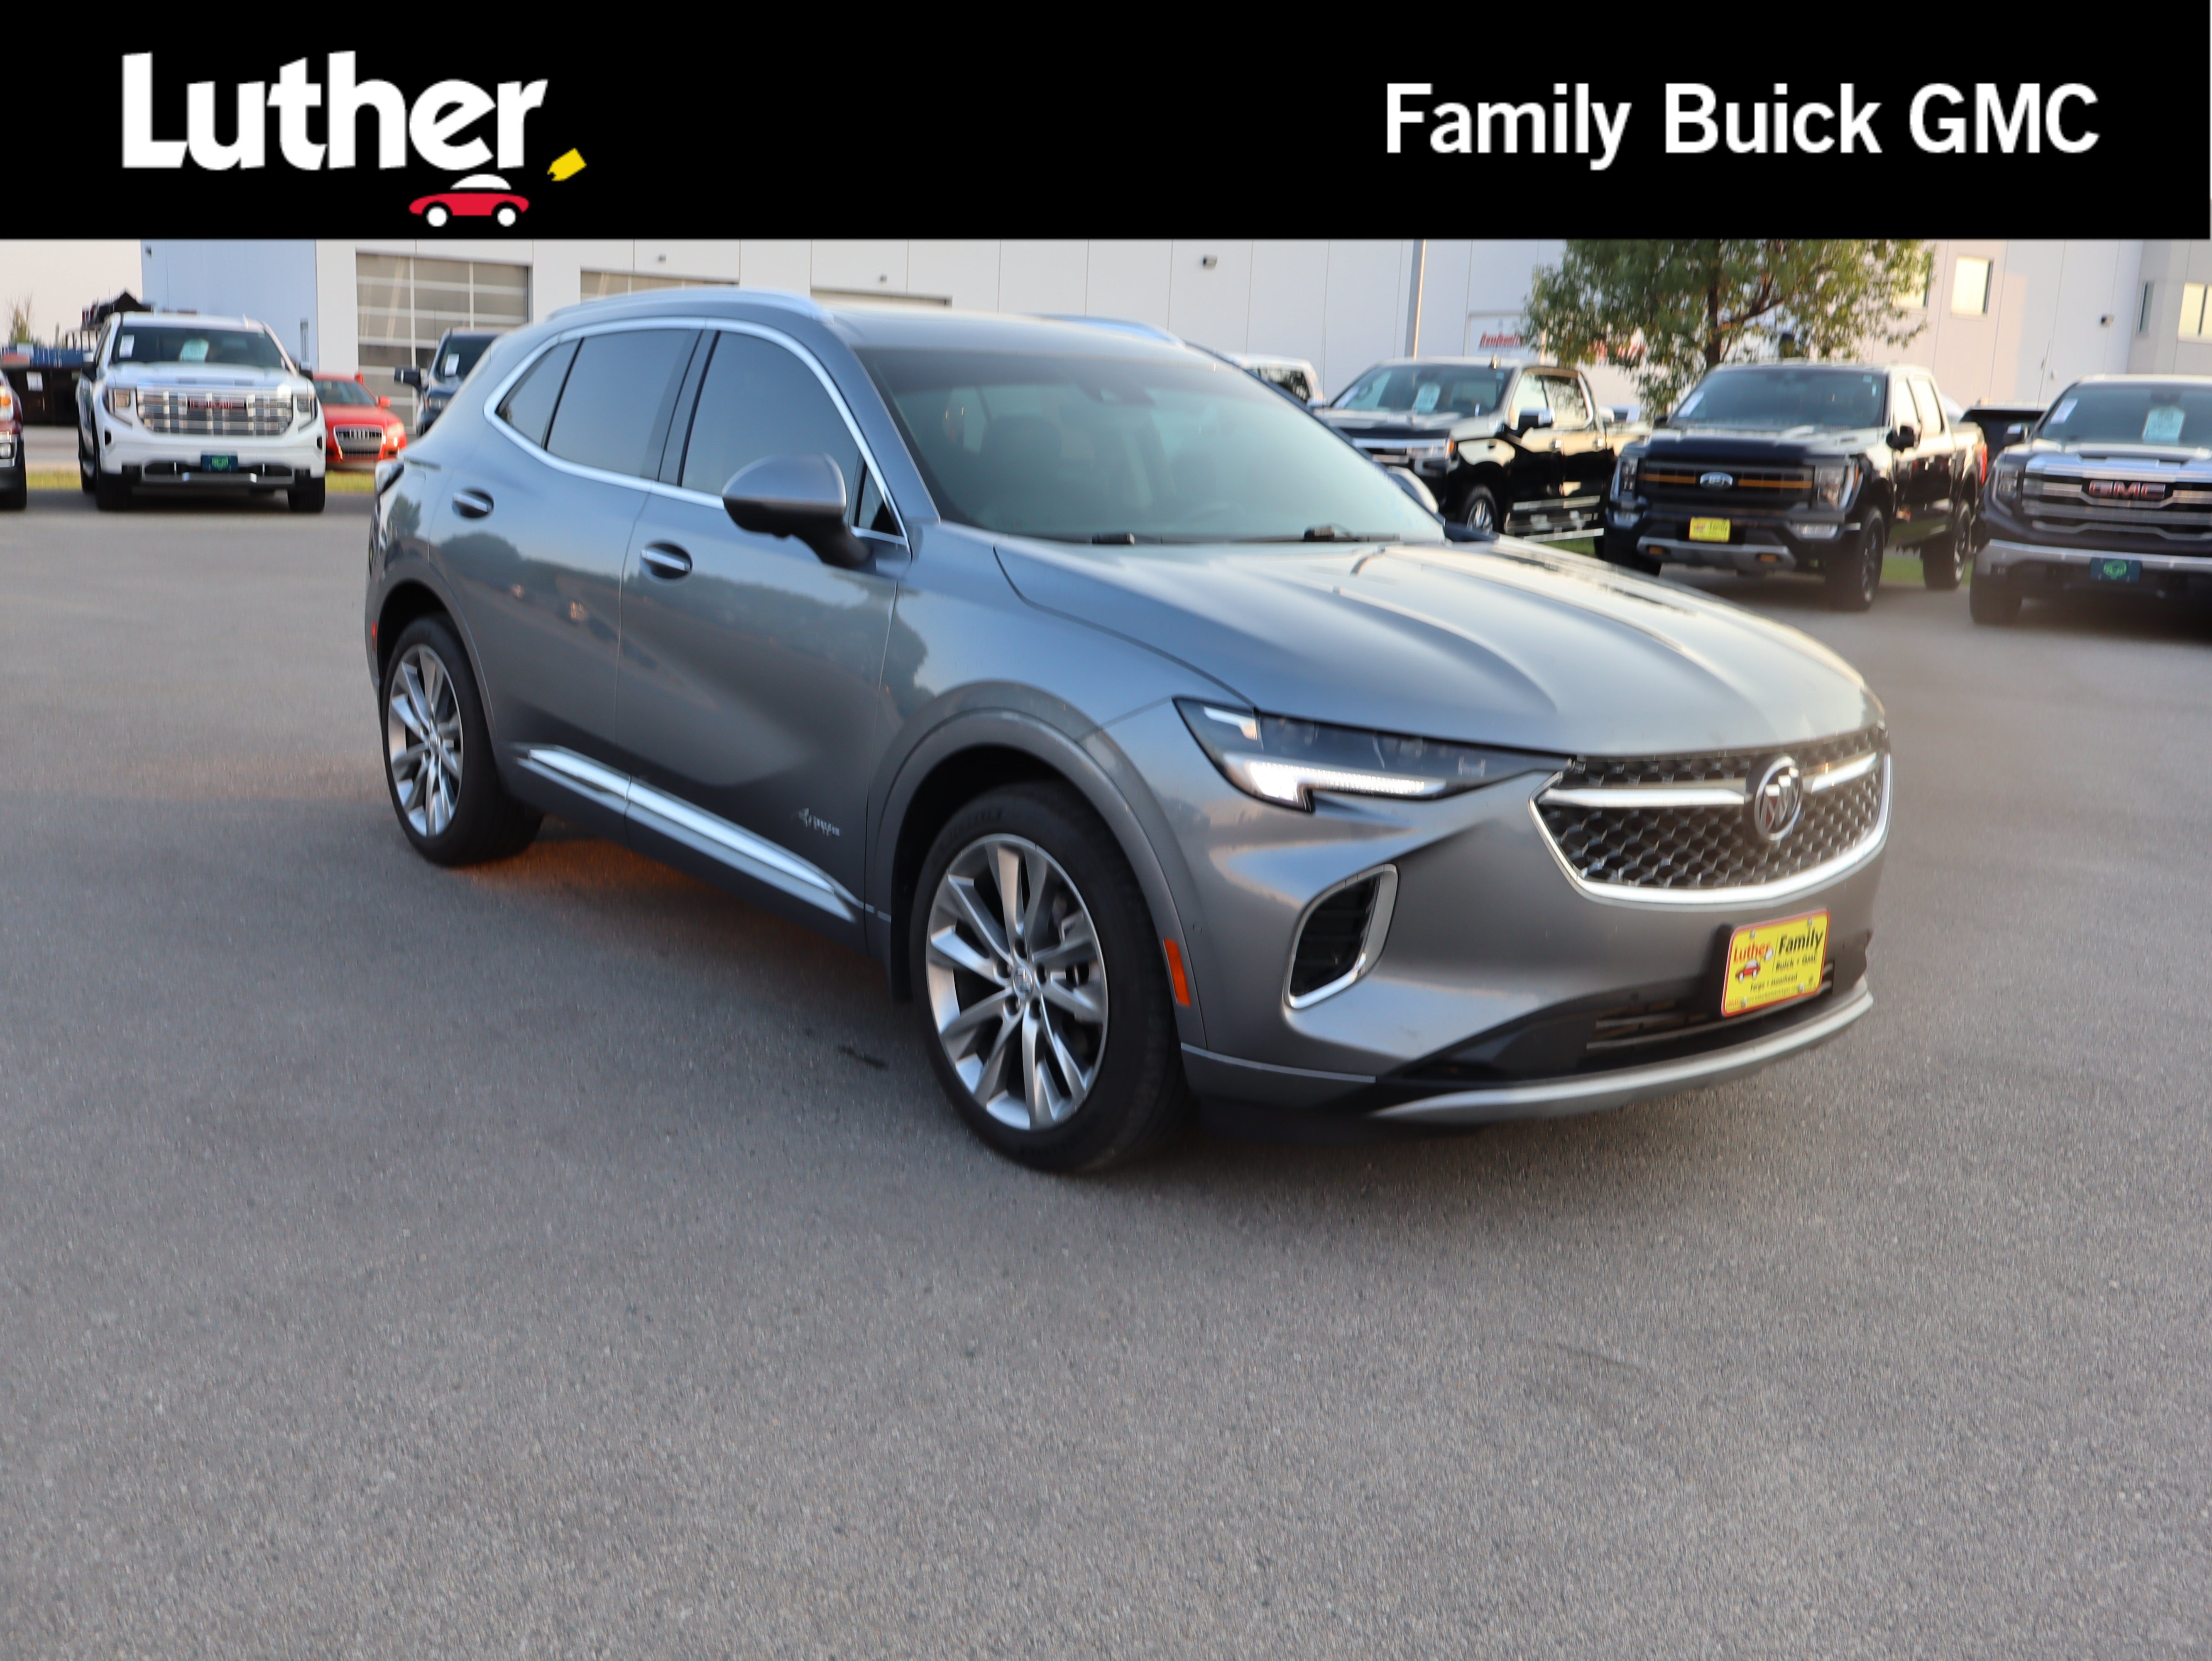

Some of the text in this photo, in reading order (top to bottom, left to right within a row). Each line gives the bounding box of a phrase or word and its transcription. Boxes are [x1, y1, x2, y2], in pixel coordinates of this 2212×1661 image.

[2089, 480, 2166, 500] GMC
[1734, 941, 1771, 963] Luther
[1779, 928, 1823, 955] Family
[1776, 958, 1794, 971] Buick
